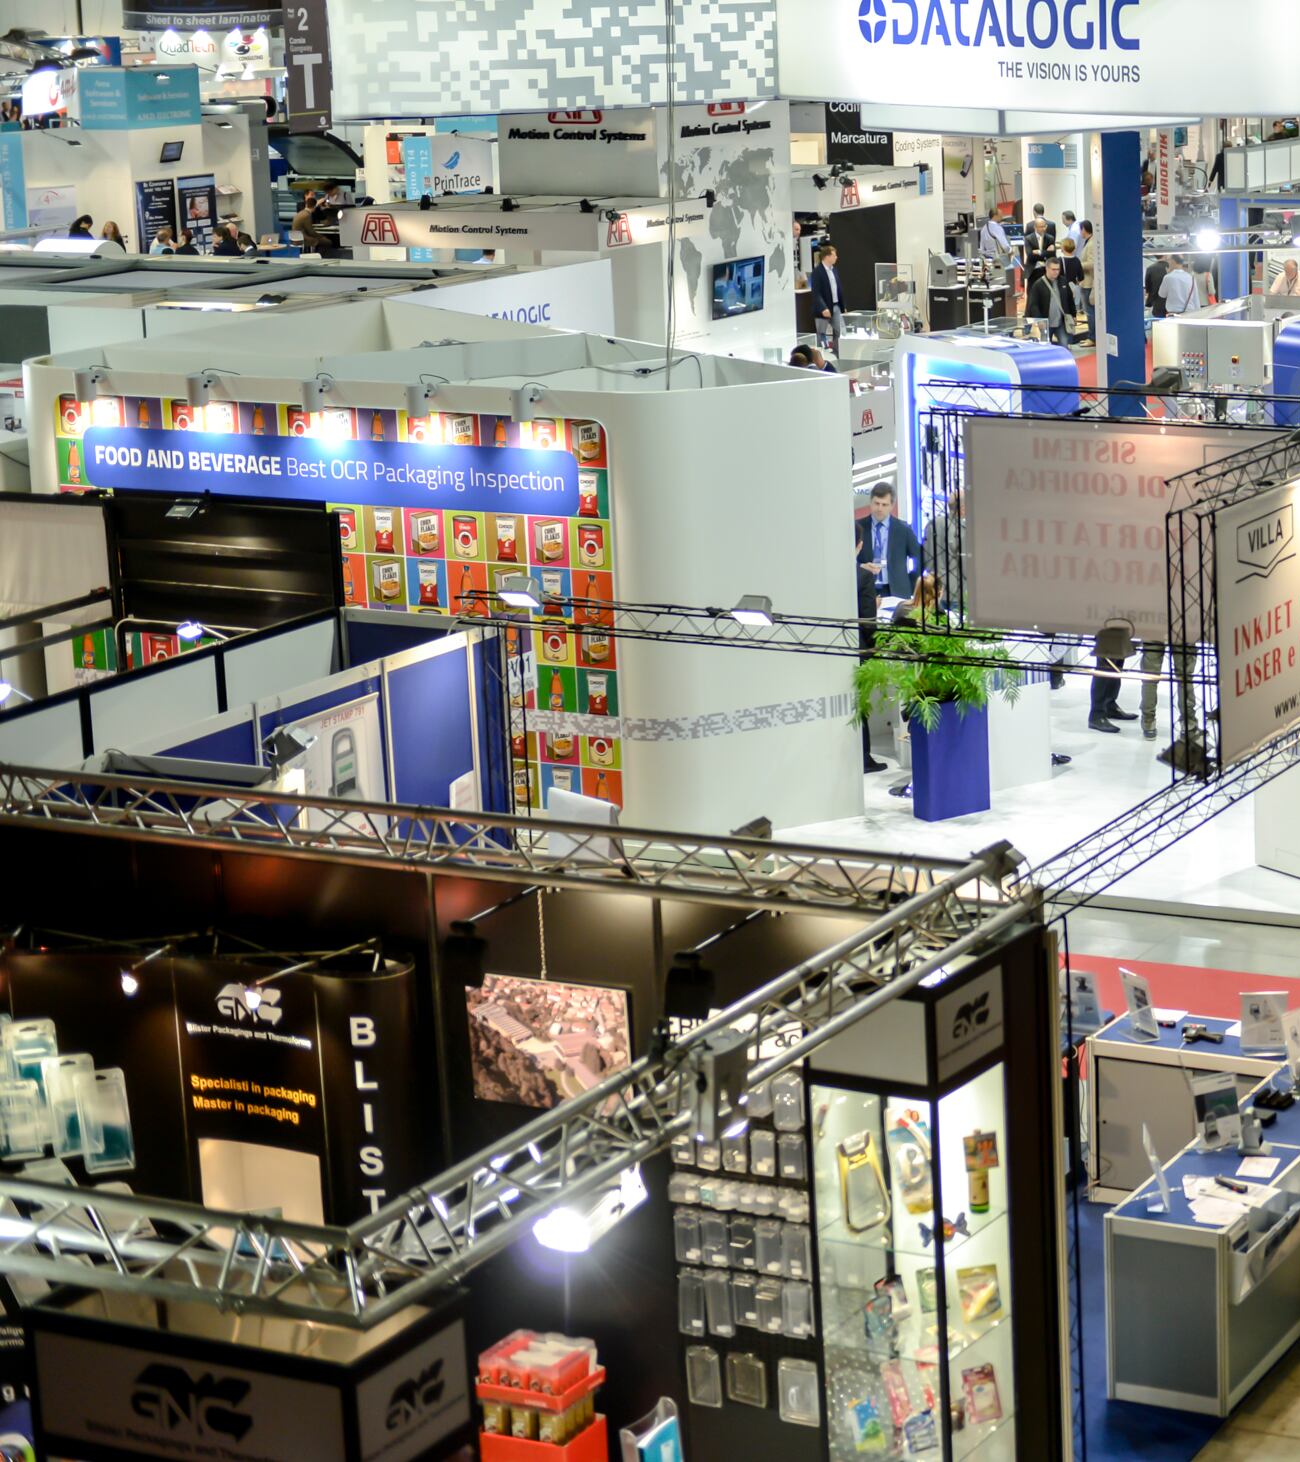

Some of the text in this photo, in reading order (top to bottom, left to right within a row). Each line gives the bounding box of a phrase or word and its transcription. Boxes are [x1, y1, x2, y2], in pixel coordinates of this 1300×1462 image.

[146, 14, 271, 25] Sheet to sheet laminator
[297, 7, 309, 31] 2
[892, 0, 1140, 50] DATALOGIC
[292, 53, 322, 109] T
[998, 61, 1140, 83] THE VISION IS YOURS
[508, 128, 646, 144] Motion Control Systems
[831, 132, 888, 144] Marcatura
[895, 141, 915, 152] Coding
[434, 174, 480, 191] PrinTrace
[429, 225, 459, 233] Motion
[461, 225, 493, 234] Control
[495, 226, 528, 236] Systems
[95, 445, 565, 493] FOOD AND BEVERAGE Best OCR Packaging Inspection
[1248, 518, 1283, 552] VILLA
[1234, 600, 1292, 656] INKJET
[510, 655, 531, 677] V1
[1235, 647, 1282, 698] LASER
[1287, 647, 1295, 668] e
[320, 716, 332, 729] JET
[332, 710, 354, 725] STAMP
[191, 1074, 316, 1108] Specialisti in packaging
[193, 1095, 299, 1125] Master in packaging
